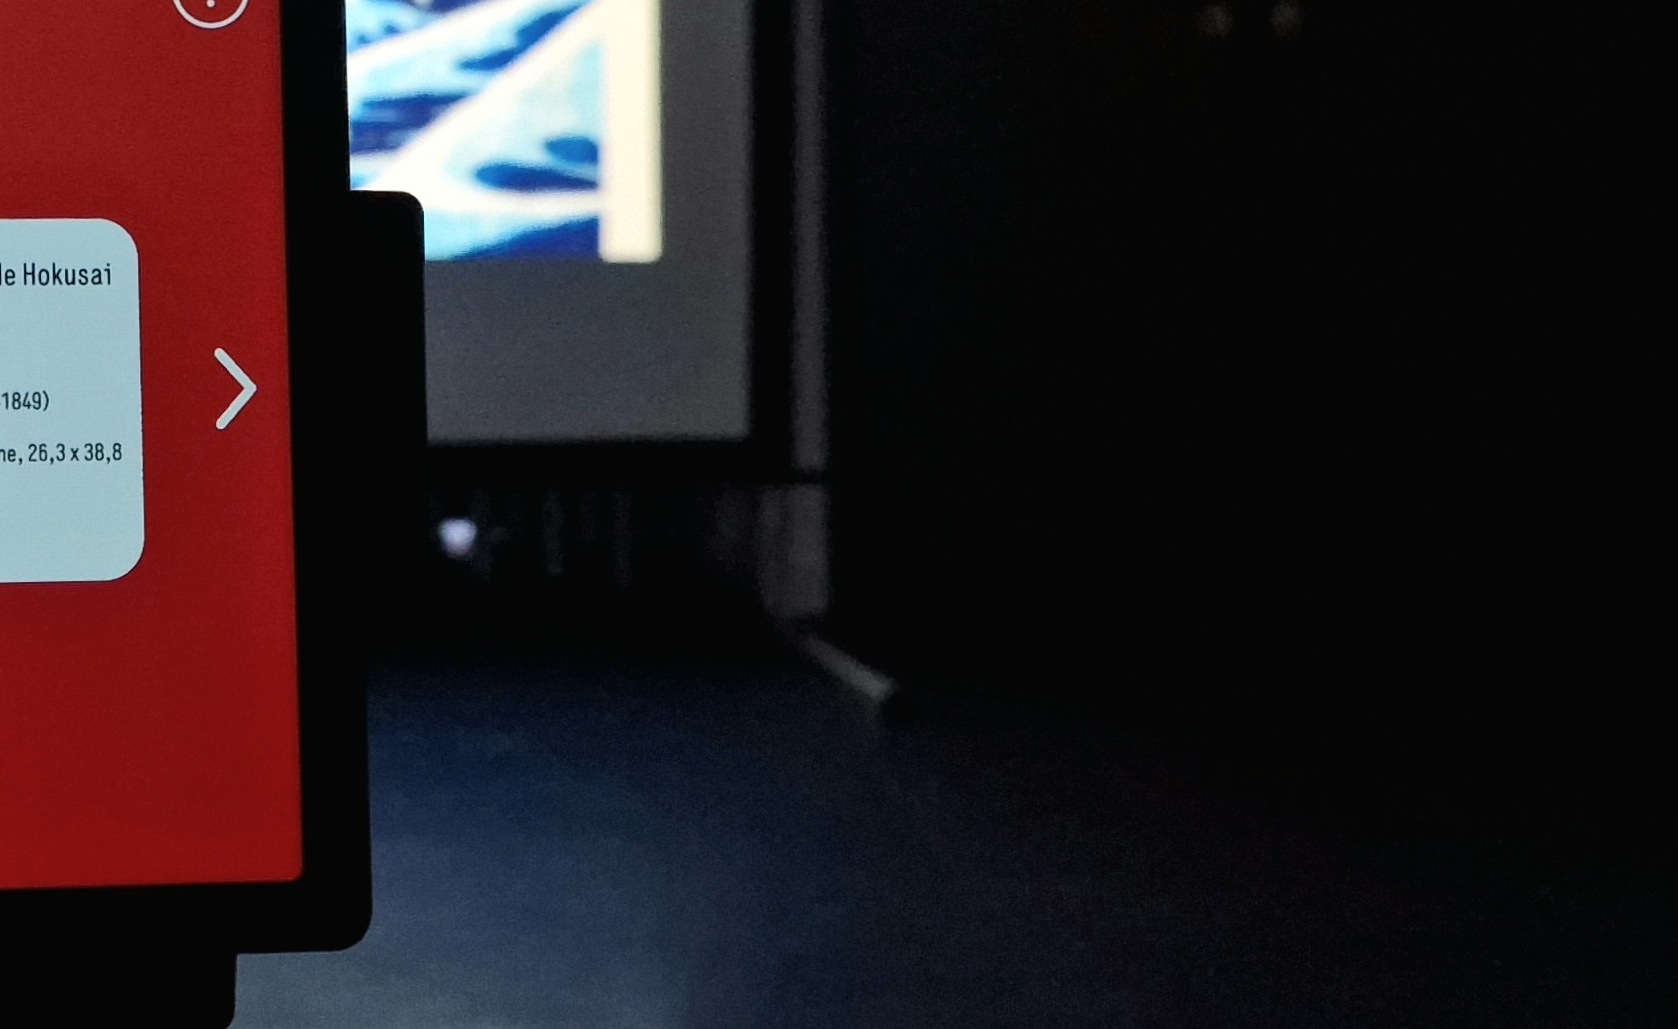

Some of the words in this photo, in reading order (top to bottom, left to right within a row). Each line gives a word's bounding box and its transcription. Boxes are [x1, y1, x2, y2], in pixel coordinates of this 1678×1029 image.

[23, 262, 112, 287] Hokusai
[28, 443, 66, 466] 26,3
[70, 448, 80, 462] x
[84, 442, 123, 465] 38,8
